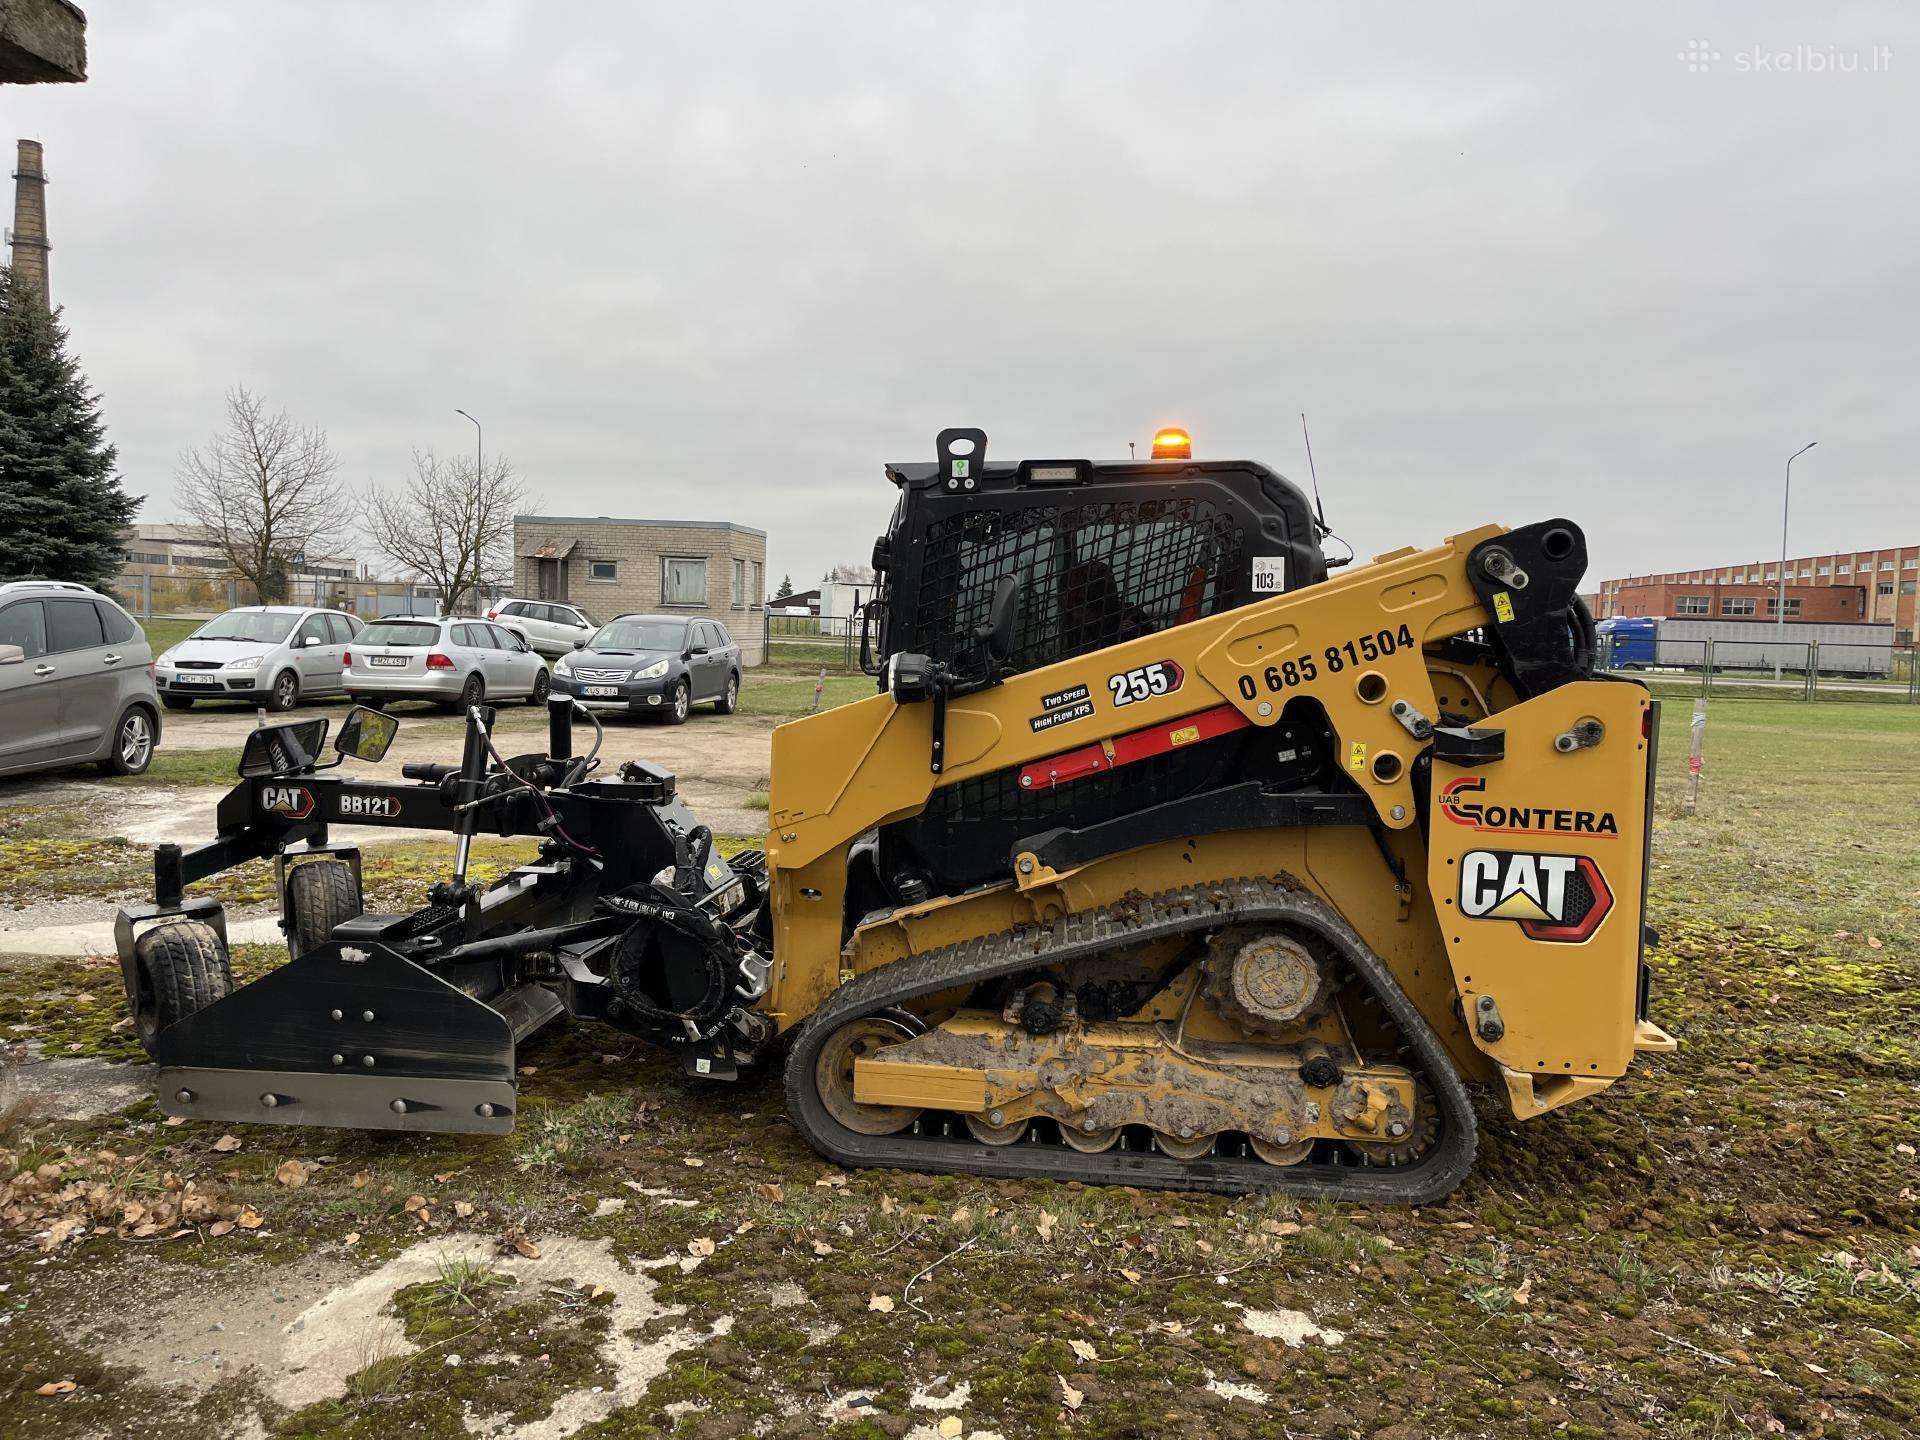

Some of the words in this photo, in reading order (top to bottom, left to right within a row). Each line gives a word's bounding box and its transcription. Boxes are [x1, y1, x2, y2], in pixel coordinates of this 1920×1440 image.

[1254, 572, 1274, 589] 103
[1237, 674, 1257, 701] 0
[1263, 654, 1318, 693] 685
[1324, 623, 1415, 673] 81504
[1109, 663, 1168, 706] 255
[1073, 704, 1090, 717] XPS
[262, 787, 301, 812] CAT
[340, 795, 390, 815] BB121
[1438, 794, 1460, 805] UAB
[1461, 850, 1577, 921] CAT
